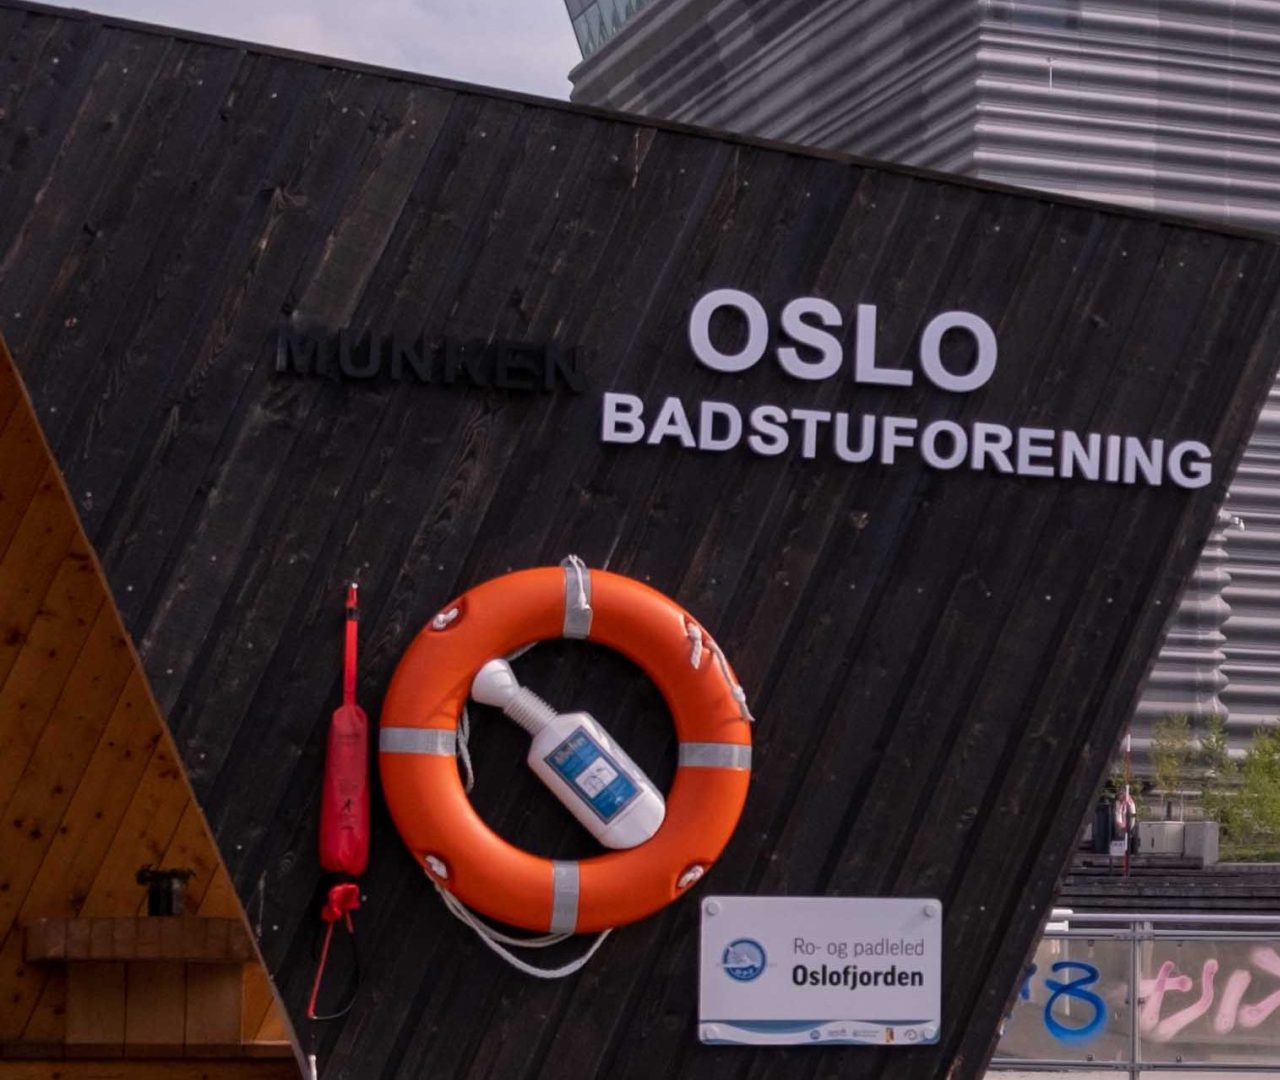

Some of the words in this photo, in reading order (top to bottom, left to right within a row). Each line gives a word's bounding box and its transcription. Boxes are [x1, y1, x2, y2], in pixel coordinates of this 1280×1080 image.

[275, 327, 587, 393] MUNKEN
[689, 288, 998, 392] OSLO
[602, 392, 1213, 488] BADSTUFORENING
[792, 963, 924, 991] Oslofjorden
[793, 937, 822, 956] Ro-
[826, 942, 848, 959] og
[853, 937, 925, 958] padleled
